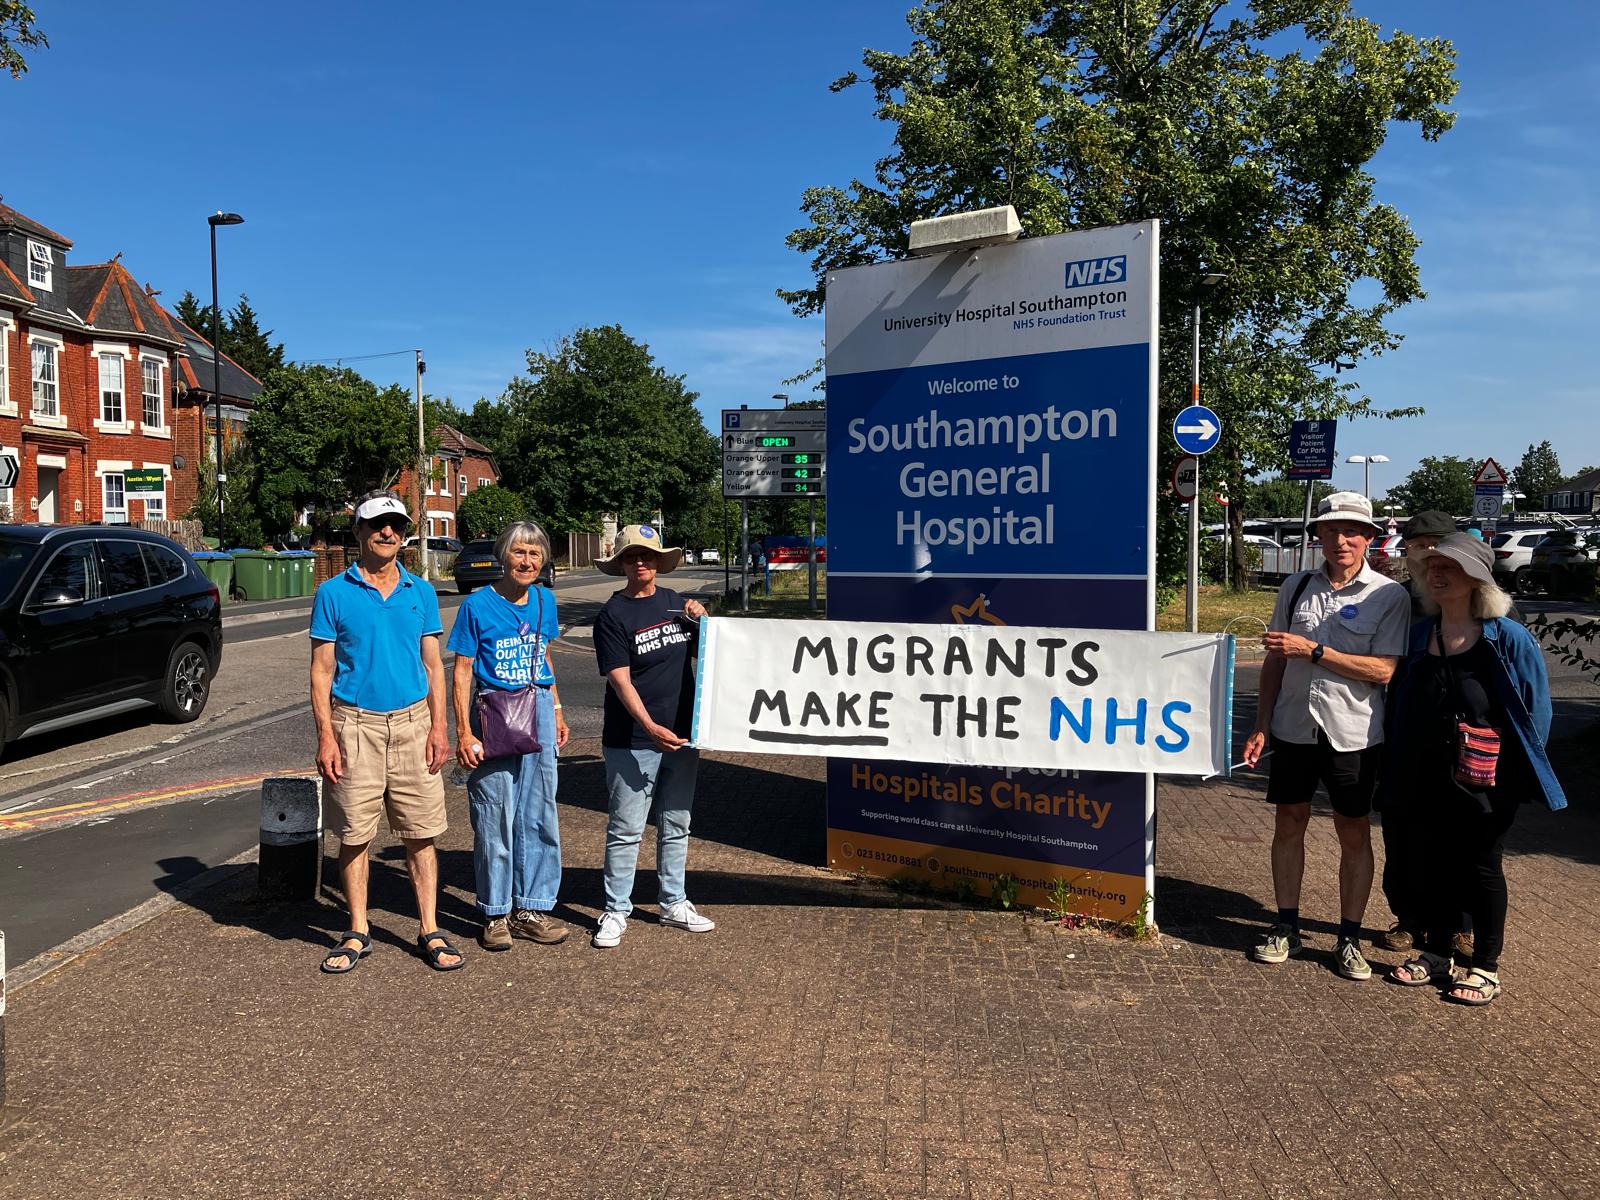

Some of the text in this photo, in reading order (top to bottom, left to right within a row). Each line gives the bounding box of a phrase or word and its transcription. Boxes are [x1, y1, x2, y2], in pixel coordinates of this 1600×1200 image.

[1067, 257, 1125, 287] NHS
[884, 290, 1127, 332] University Hospital Southampton
[1013, 308, 1127, 330] NHS Foundation Trust
[928, 374, 1020, 396] Welcome to
[728, 415, 738, 427] P
[848, 405, 1118, 454] Southampton
[736, 437, 754, 445] Blue
[762, 438, 789, 447] OPEN
[726, 454, 780, 464] Orange Upper
[794, 455, 808, 464] 35
[726, 468, 780, 479] Orange Lower
[794, 469, 808, 478] 42
[899, 452, 1050, 498] General
[726, 483, 751, 491] Yellow
[794, 484, 808, 492] 34
[896, 503, 1054, 555] Hospital
[635, 623, 682, 645] KEEP OUR
[495, 649, 517, 660] OUR
[637, 639, 661, 655] NHS
[495, 661, 510, 670] AS
[511, 660, 519, 669] A
[792, 634, 1100, 686] MIGRANTS
[749, 689, 1192, 753] MAKE THE NHS
[851, 763, 1113, 830] Hospitals Charity
[861, 808, 1099, 852] Supporting world class care at University Hospital Southampton
[856, 848, 922, 868] 023 8120 8881
